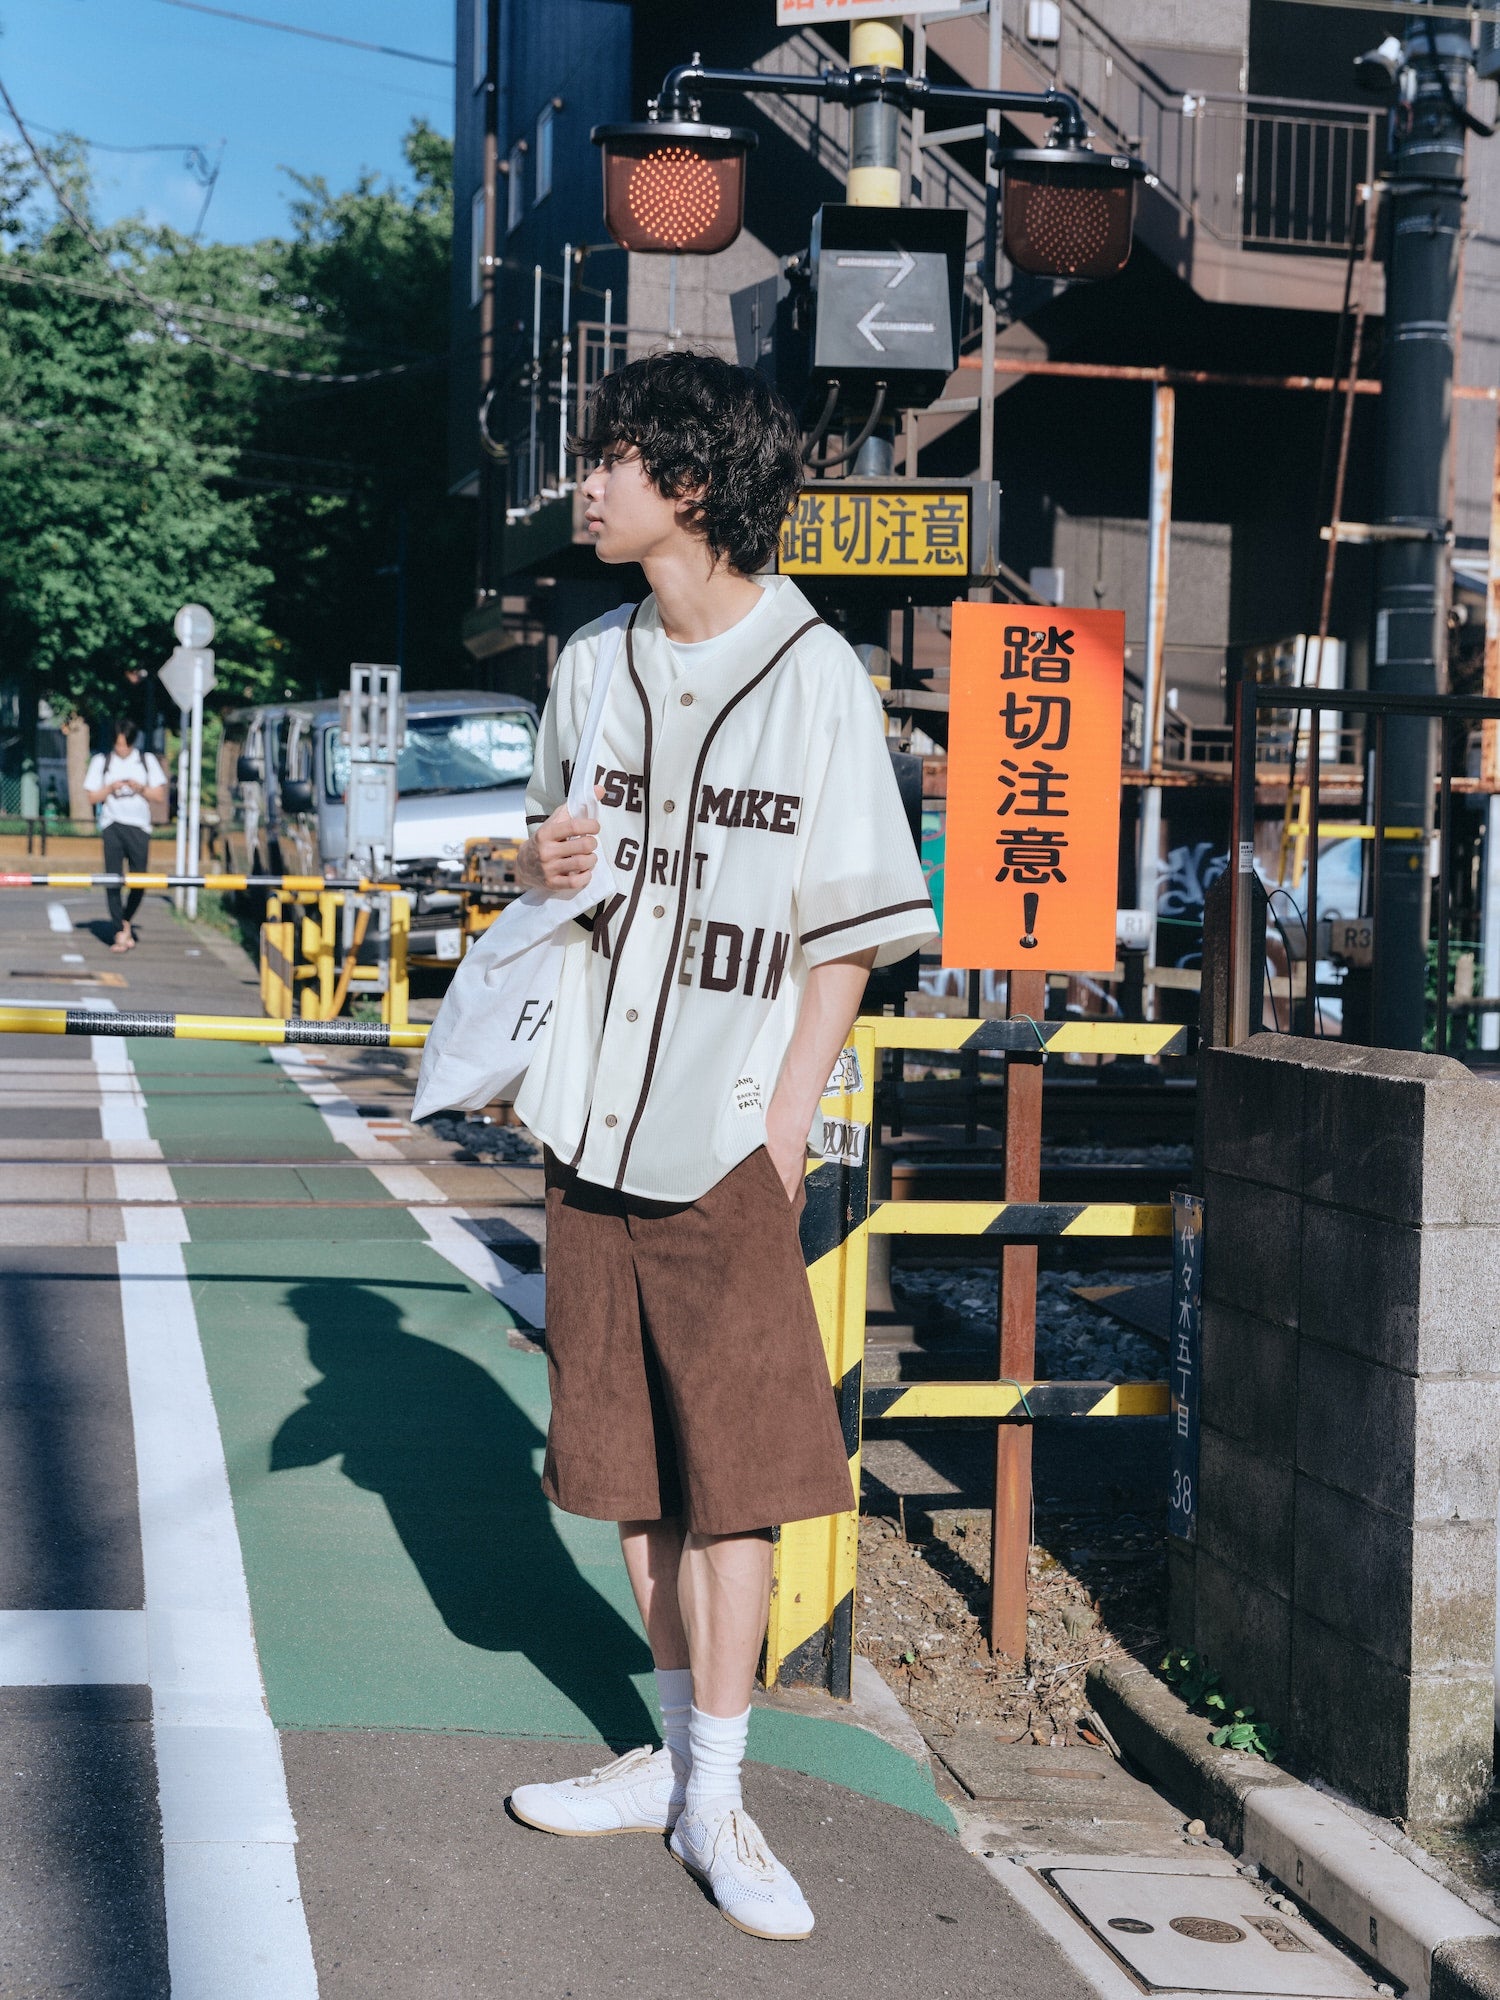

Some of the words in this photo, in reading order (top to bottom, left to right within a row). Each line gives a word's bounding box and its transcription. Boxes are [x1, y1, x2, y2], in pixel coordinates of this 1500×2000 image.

[782, 496, 965, 566] 踏切注意
[697, 784, 803, 836] MAKE
[995, 625, 1075, 949] 踏切注意！
[614, 837, 708, 890] GRIT
[1344, 927, 1371, 949] R3
[1176, 1225, 1195, 1438] 代々木五丁目
[1172, 1469, 1192, 1515] 38
